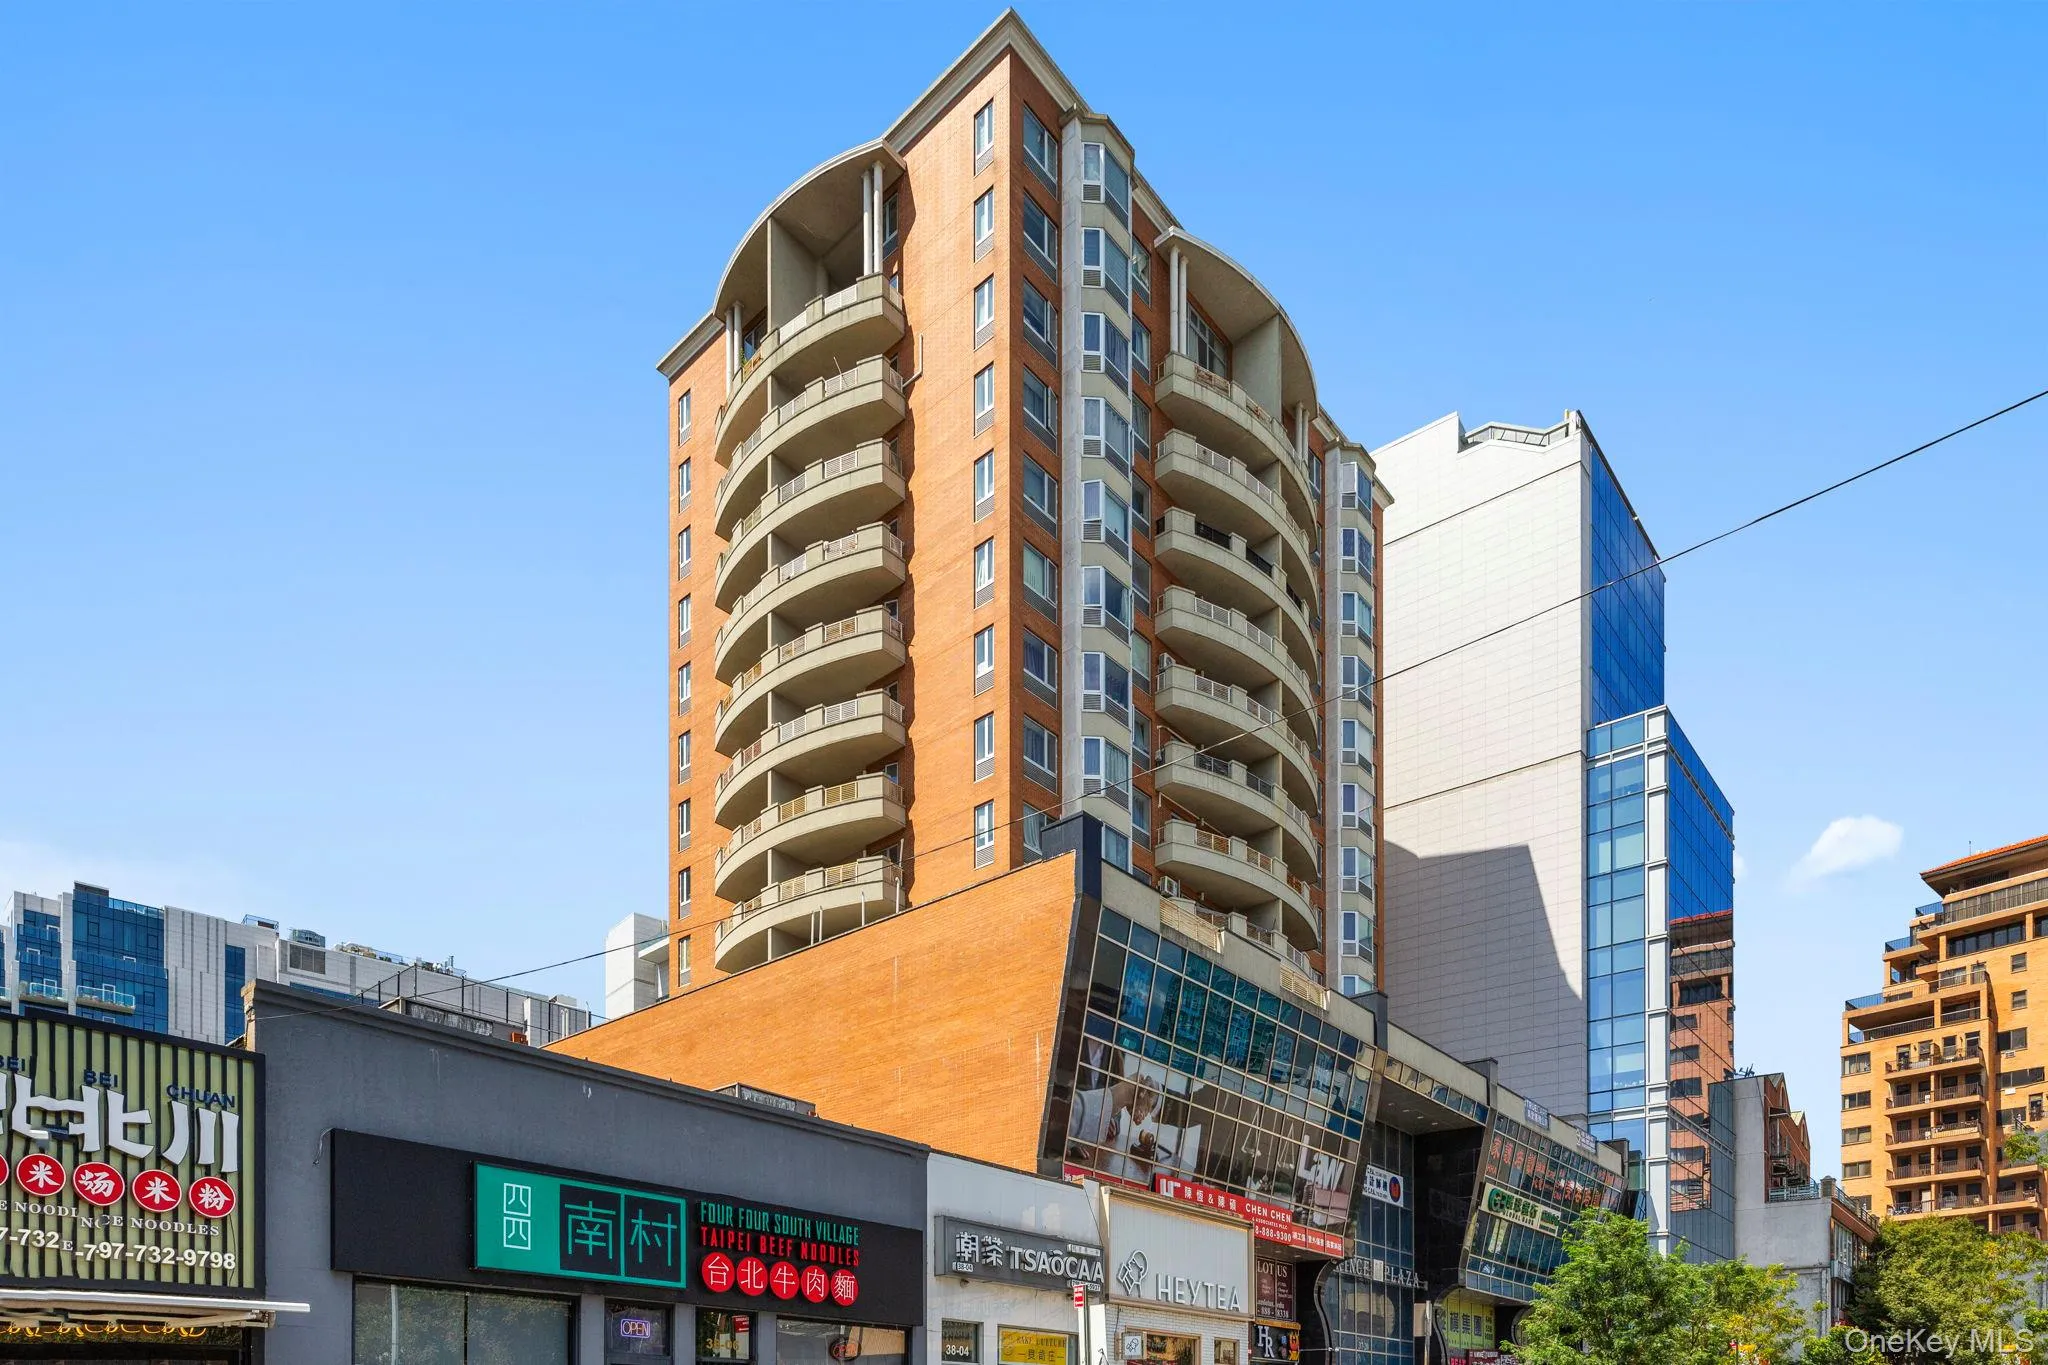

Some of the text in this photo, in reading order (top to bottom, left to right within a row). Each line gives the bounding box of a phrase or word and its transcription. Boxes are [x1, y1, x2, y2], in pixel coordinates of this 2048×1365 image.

[84, 1068, 118, 1088] BEI
[166, 1084, 235, 1108] CHUAN
[1298, 1135, 1344, 1191] Law
[701, 1200, 859, 1245] FOUR FOUR SOUTH VILLAGE
[1245, 1203, 1291, 1223] CHEN CHEN
[131, 1217, 220, 1236] NOODLES
[565, 1201, 677, 1267] 南村
[701, 1226, 859, 1267] TAIPEI BEEF NOODLES
[708, 1256, 855, 1300] 台北牛肉麵
[1385, 1265, 1420, 1288] PLAZA
[1156, 1273, 1241, 1311] HEYTEA
[622, 1321, 649, 1337] OPEN
[706, 1338, 740, 1351] 38-06
[945, 1344, 969, 1357] 38-04
